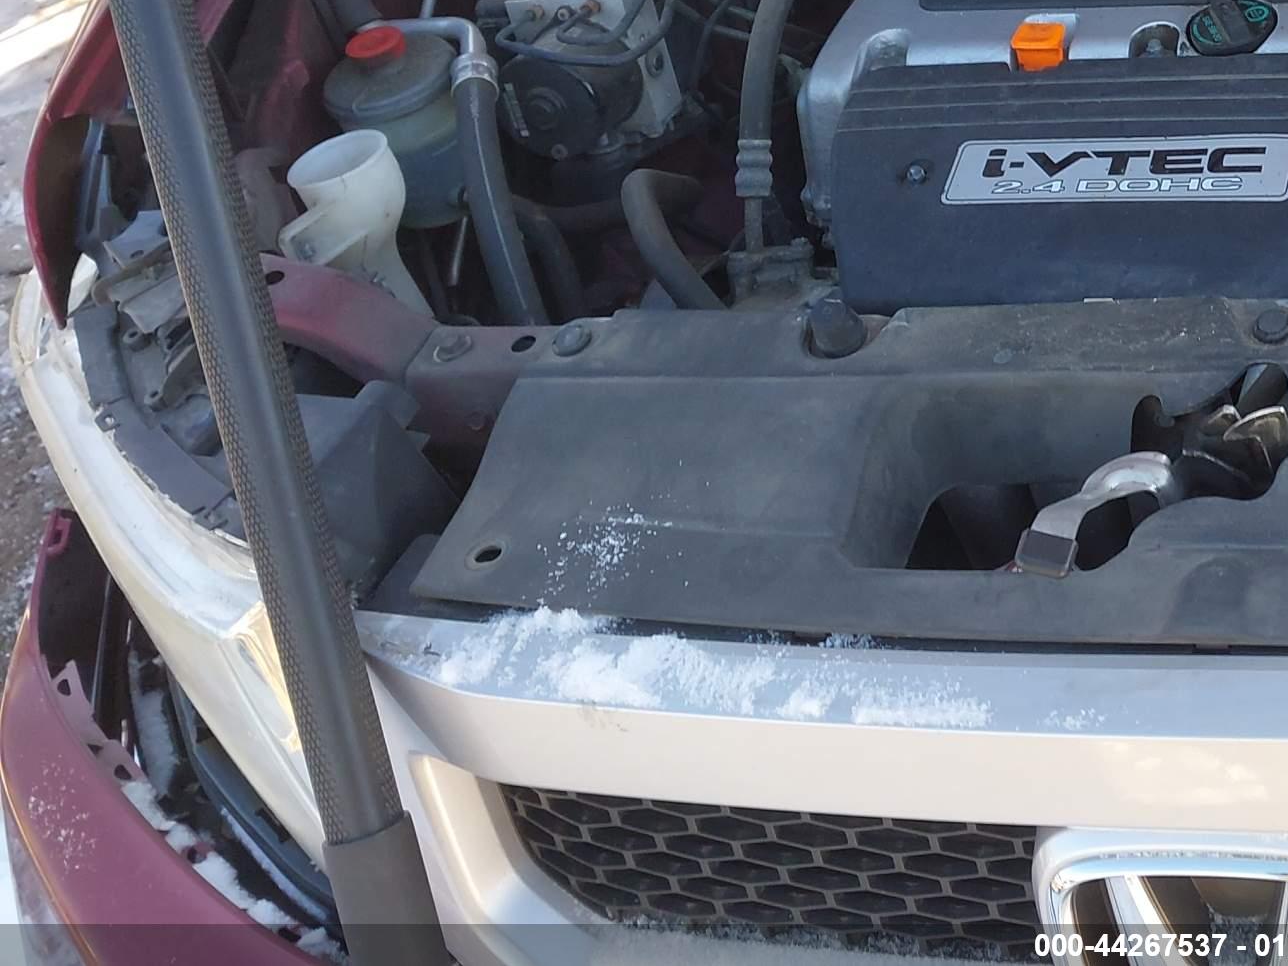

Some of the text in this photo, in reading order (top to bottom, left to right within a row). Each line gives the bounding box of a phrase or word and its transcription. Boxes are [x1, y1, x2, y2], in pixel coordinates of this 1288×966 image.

[982, 146, 1267, 179] i-VTEC
[991, 176, 1243, 195] 2.4 DOHC
